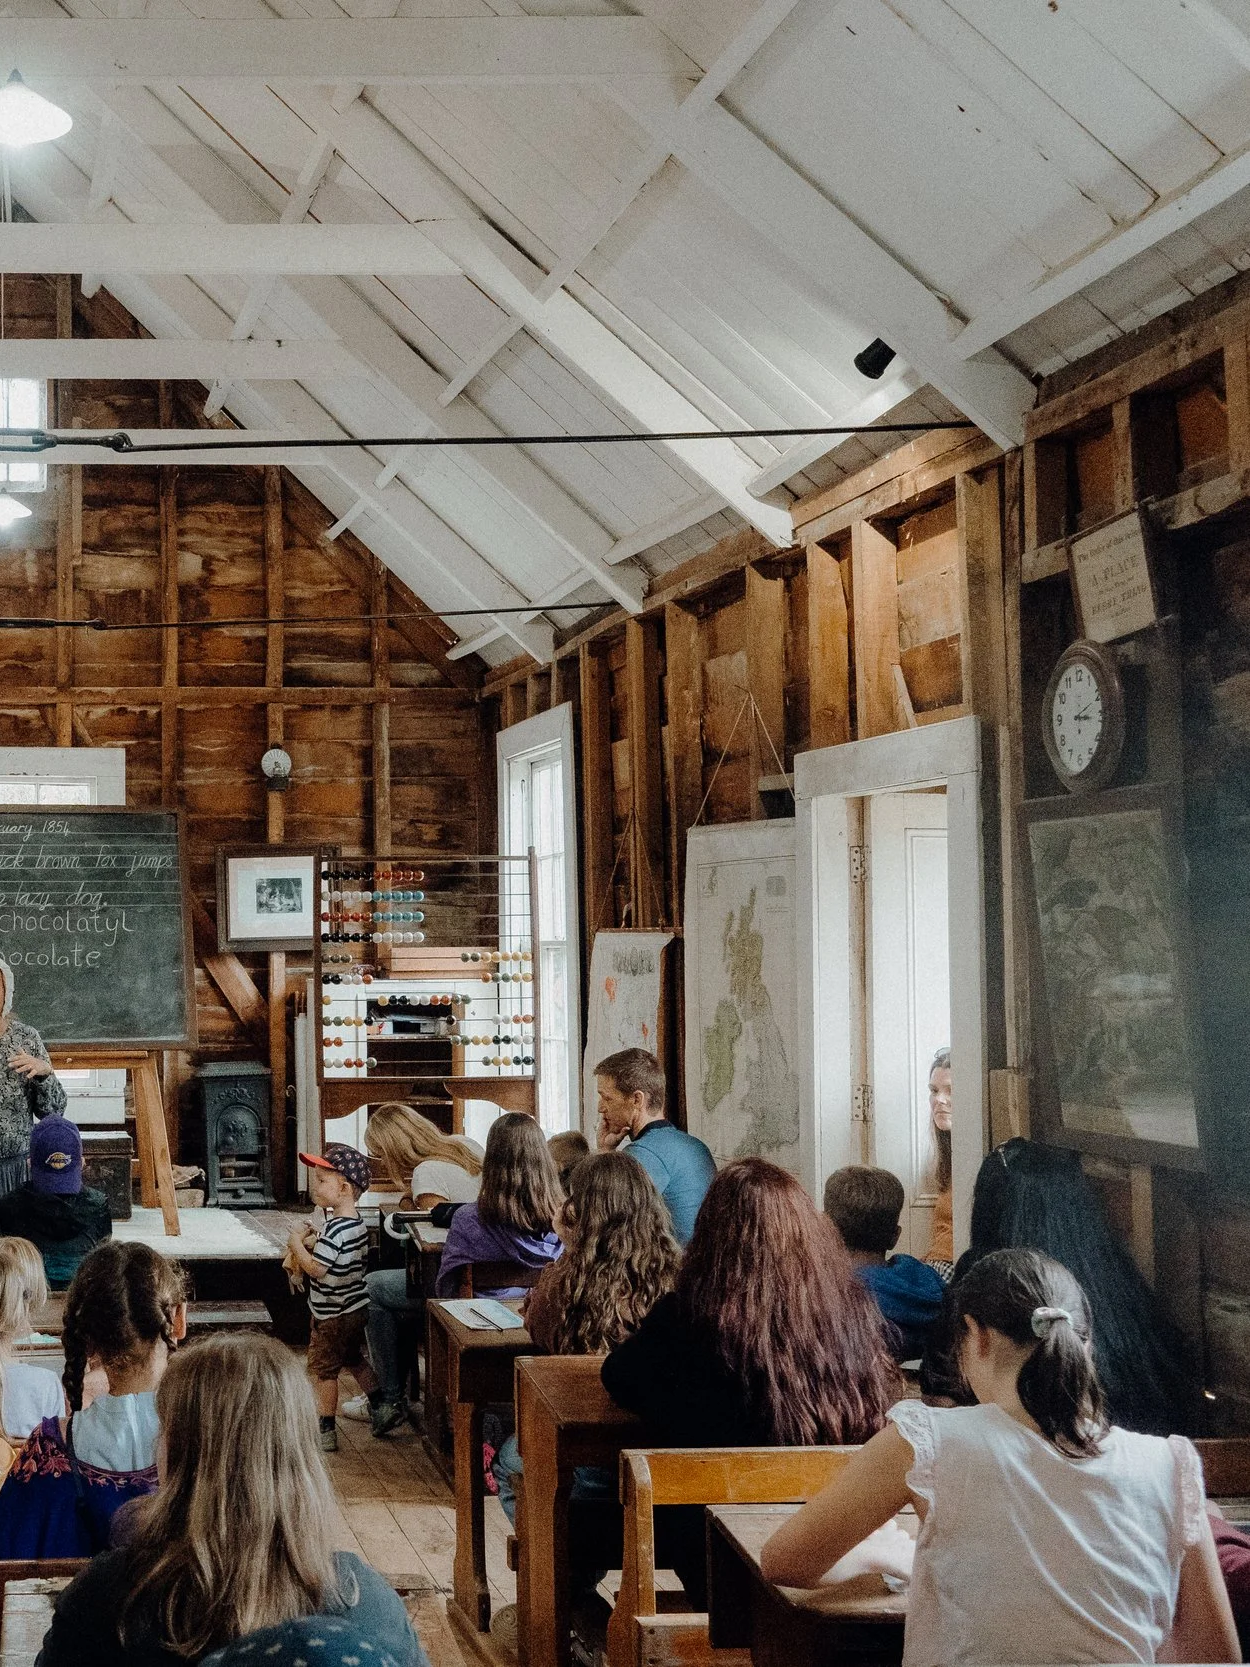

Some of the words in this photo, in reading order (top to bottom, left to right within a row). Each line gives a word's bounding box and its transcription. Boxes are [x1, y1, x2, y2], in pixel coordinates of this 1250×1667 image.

[1076, 669, 1082, 682] 12
[1065, 677, 1071, 688] 11
[1059, 693, 1066, 704] 10
[1057, 714, 1062, 726] 9
[1060, 735, 1066, 746] 8
[1068, 749, 1073, 757] 7
[1076, 754, 1082, 766] 6
[42, 820, 71, 836] 1854
[35, 844, 81, 868] brown
[95, 844, 117, 868] fox
[125, 851, 173, 878] jumps
[14, 881, 53, 911] lazy
[66, 881, 108, 912] dog.
